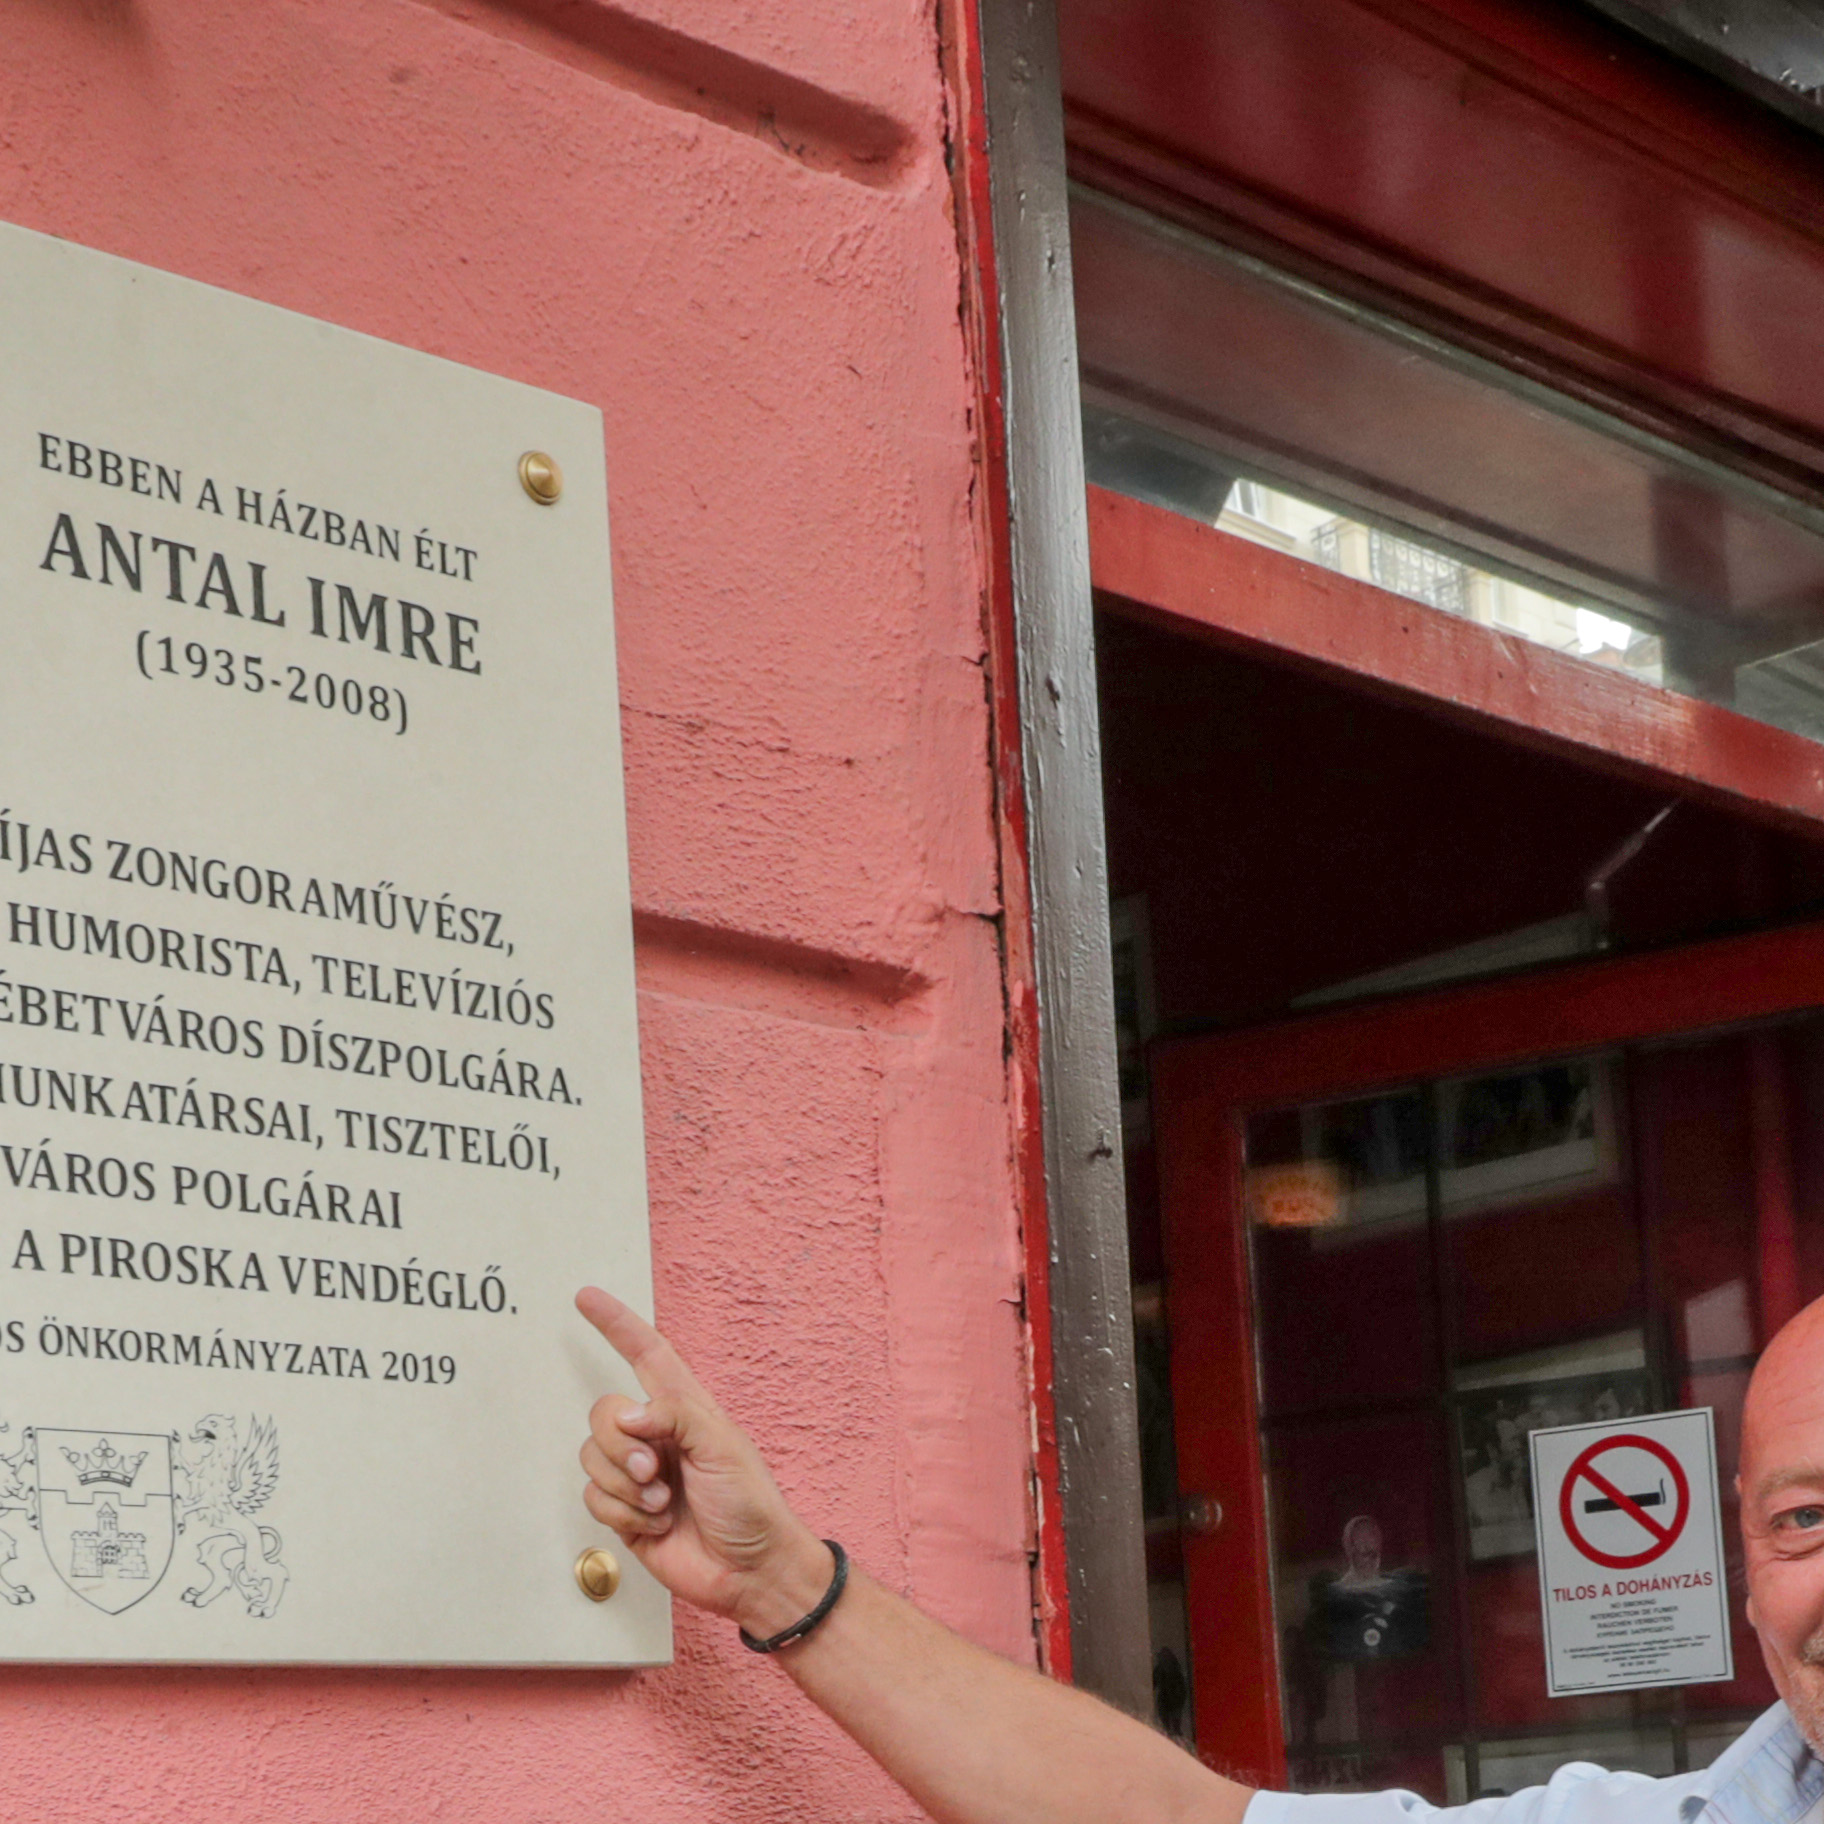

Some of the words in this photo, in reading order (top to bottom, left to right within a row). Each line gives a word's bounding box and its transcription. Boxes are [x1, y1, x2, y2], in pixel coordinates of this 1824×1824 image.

[38, 432, 181, 503] EBBEN
[197, 478, 223, 515] A
[236, 487, 400, 562] HÁZBAN
[414, 528, 477, 581] ÉLT
[39, 513, 285, 627] ANTAL
[307, 577, 481, 675] IMRE
[137, 630, 407, 735] (1935-2008)
[107, 840, 513, 957] ZONGORAMŰVÉSZ,
[7, 902, 300, 995] HUMORISTA,
[312, 954, 554, 1029] TELEVÍZIÓS
[279, 1019, 581, 1105] DÍSZPOLGÁRA.
[336, 1109, 559, 1180] TISZTELŐI,
[172, 1166, 402, 1229] POLGÁRAI
[12, 1229, 45, 1271] A
[59, 1233, 269, 1292] PIROSKA
[278, 1255, 517, 1314] VENDÉGLŐ.
[39, 1316, 370, 1379] ÖNKORMÁNYZATA
[382, 1351, 456, 1384] 2019
[1553, 1585, 1597, 1602] TILOS
[1601, 1583, 1612, 1597] A
[1616, 1569, 1713, 1596] DOHÁNYZÁS
